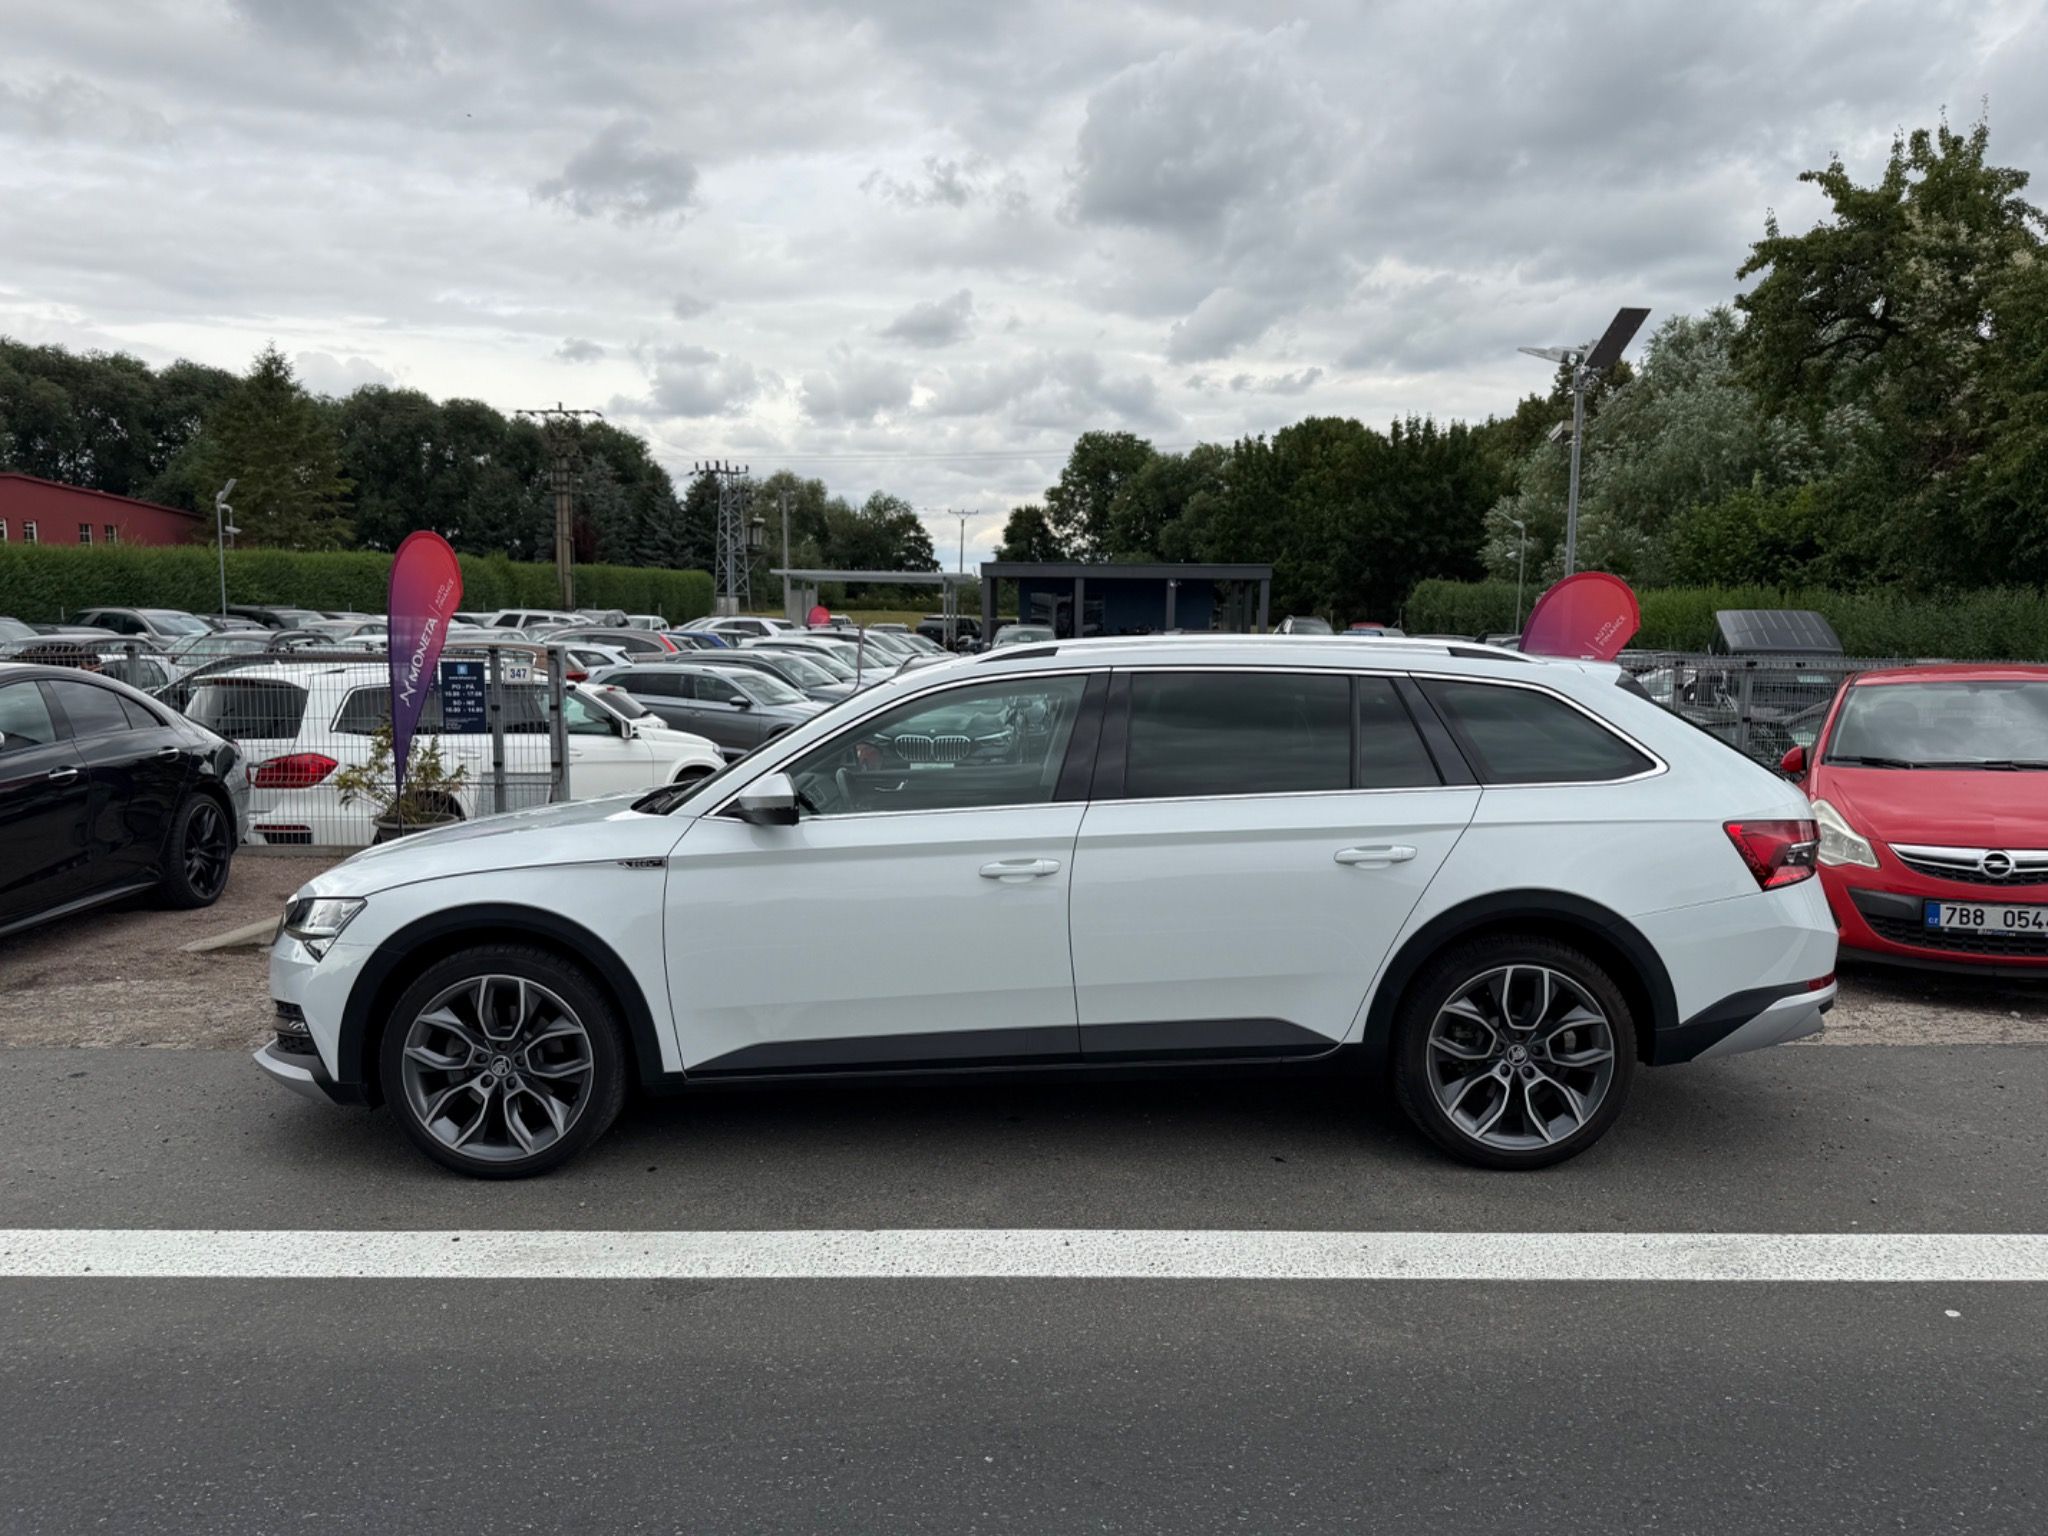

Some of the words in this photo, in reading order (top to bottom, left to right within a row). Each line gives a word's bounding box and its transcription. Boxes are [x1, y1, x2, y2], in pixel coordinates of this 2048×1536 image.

[434, 584, 445, 604] AUTO
[1594, 622, 1612, 642] AUTO
[1599, 615, 1627, 647] FINANCE
[408, 617, 439, 682] MONETA
[510, 668, 527, 679] 347
[1945, 906, 1985, 926] 7B8
[2003, 909, 2048, 929] 054
